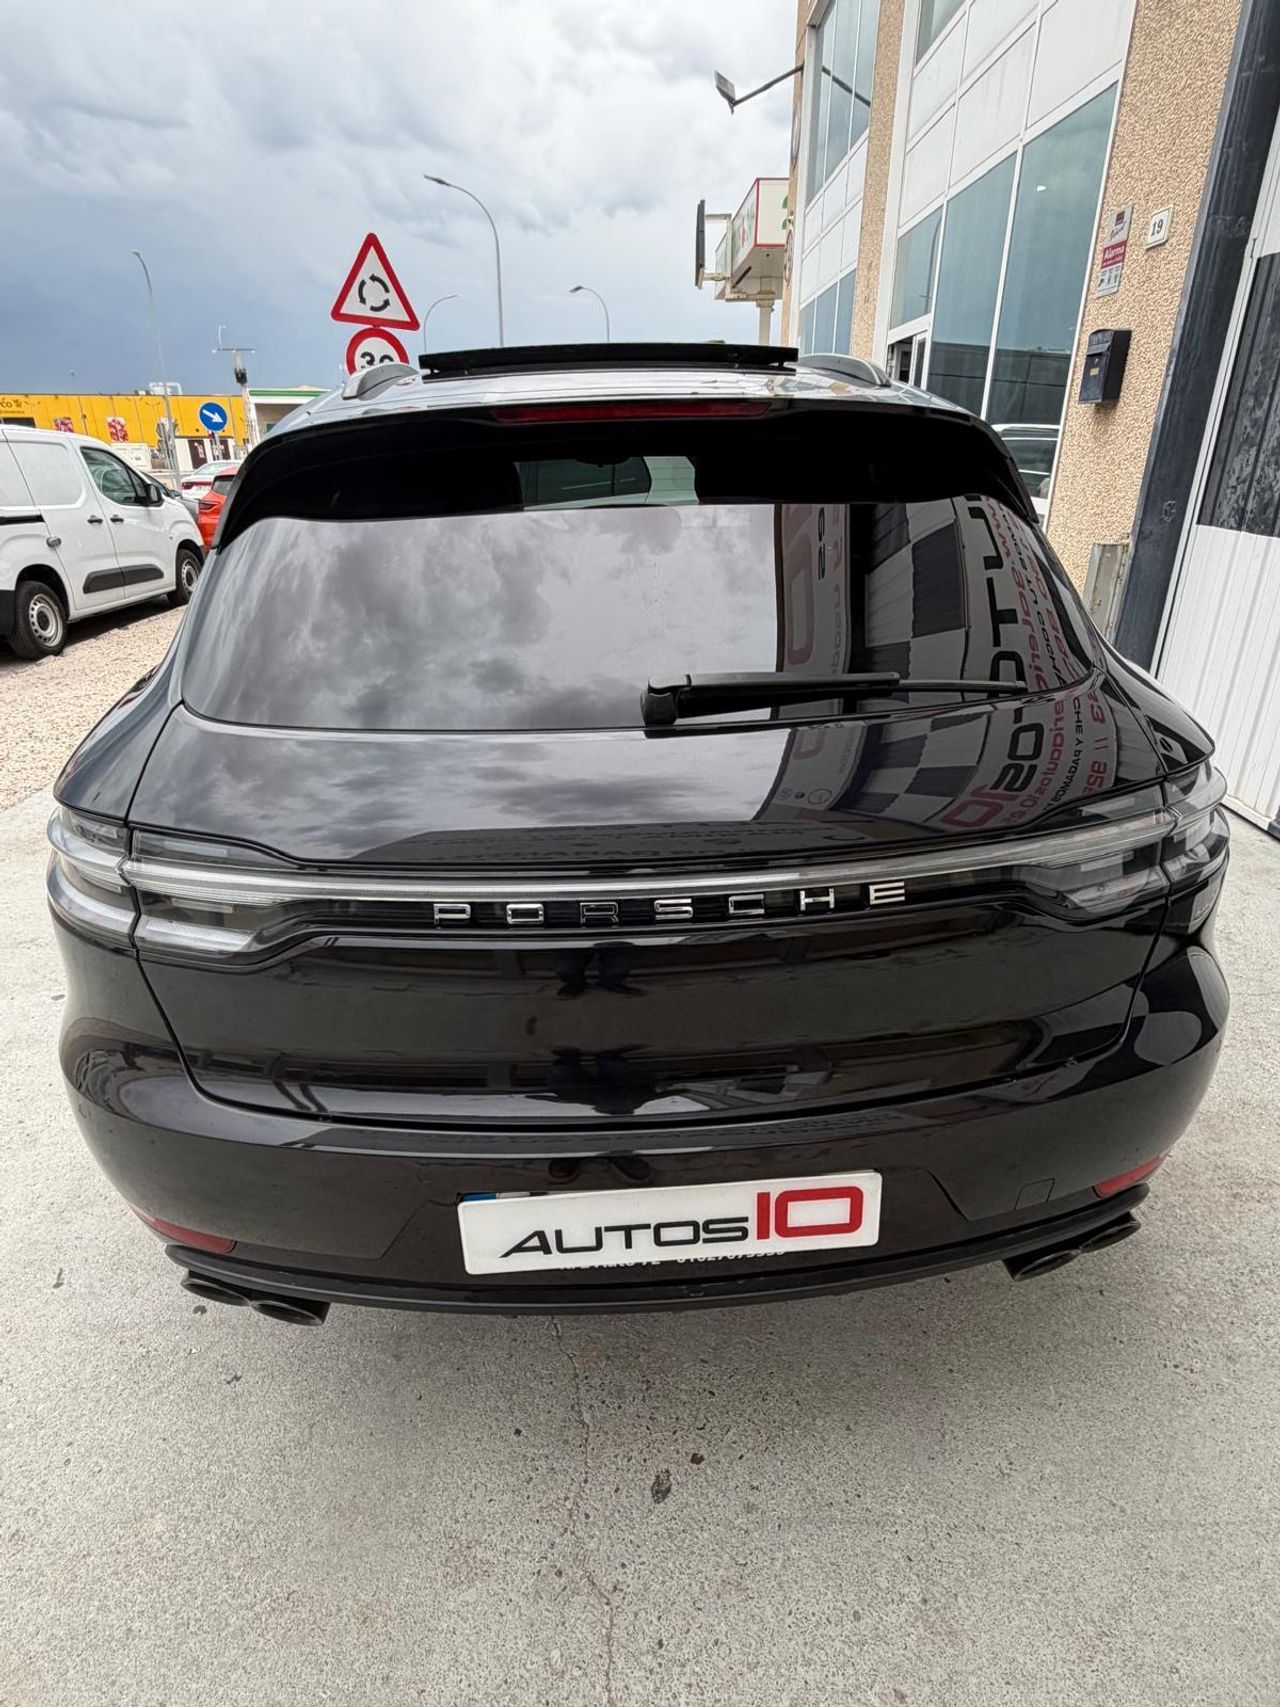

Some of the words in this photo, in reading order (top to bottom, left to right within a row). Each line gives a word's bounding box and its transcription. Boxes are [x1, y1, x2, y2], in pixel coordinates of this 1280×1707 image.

[1151, 218, 1164, 237] 19
[433, 881, 905, 928] PORSCHE
[499, 1186, 864, 1258] AUTOS10
